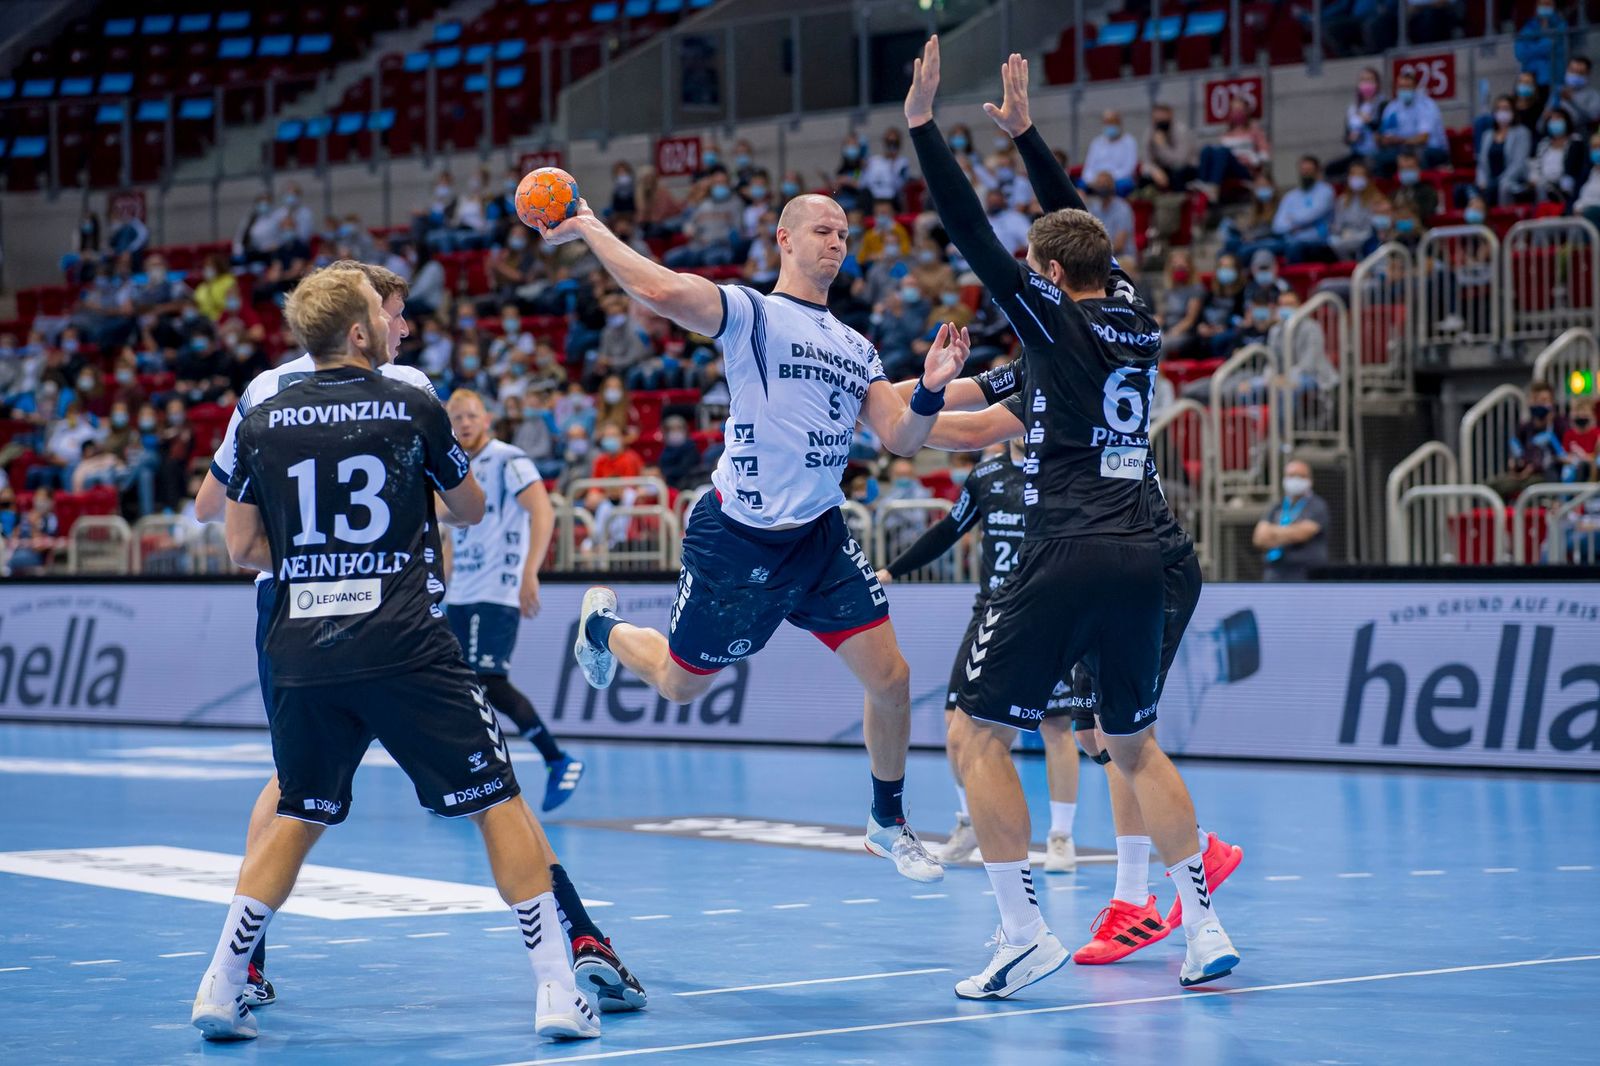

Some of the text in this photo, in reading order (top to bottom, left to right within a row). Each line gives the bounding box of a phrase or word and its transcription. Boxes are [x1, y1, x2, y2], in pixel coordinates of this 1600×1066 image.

[269, 401, 412, 428] PROVINZIAL
[287, 454, 391, 546] 13
[317, 591, 372, 605] LEDVANCE
[1390, 605, 1429, 623] VON
[1437, 597, 1504, 617] GRUND
[1512, 596, 1548, 612] AUF
[1339, 619, 1600, 751] hella
[456, 777, 503, 803] DSK-BIG
